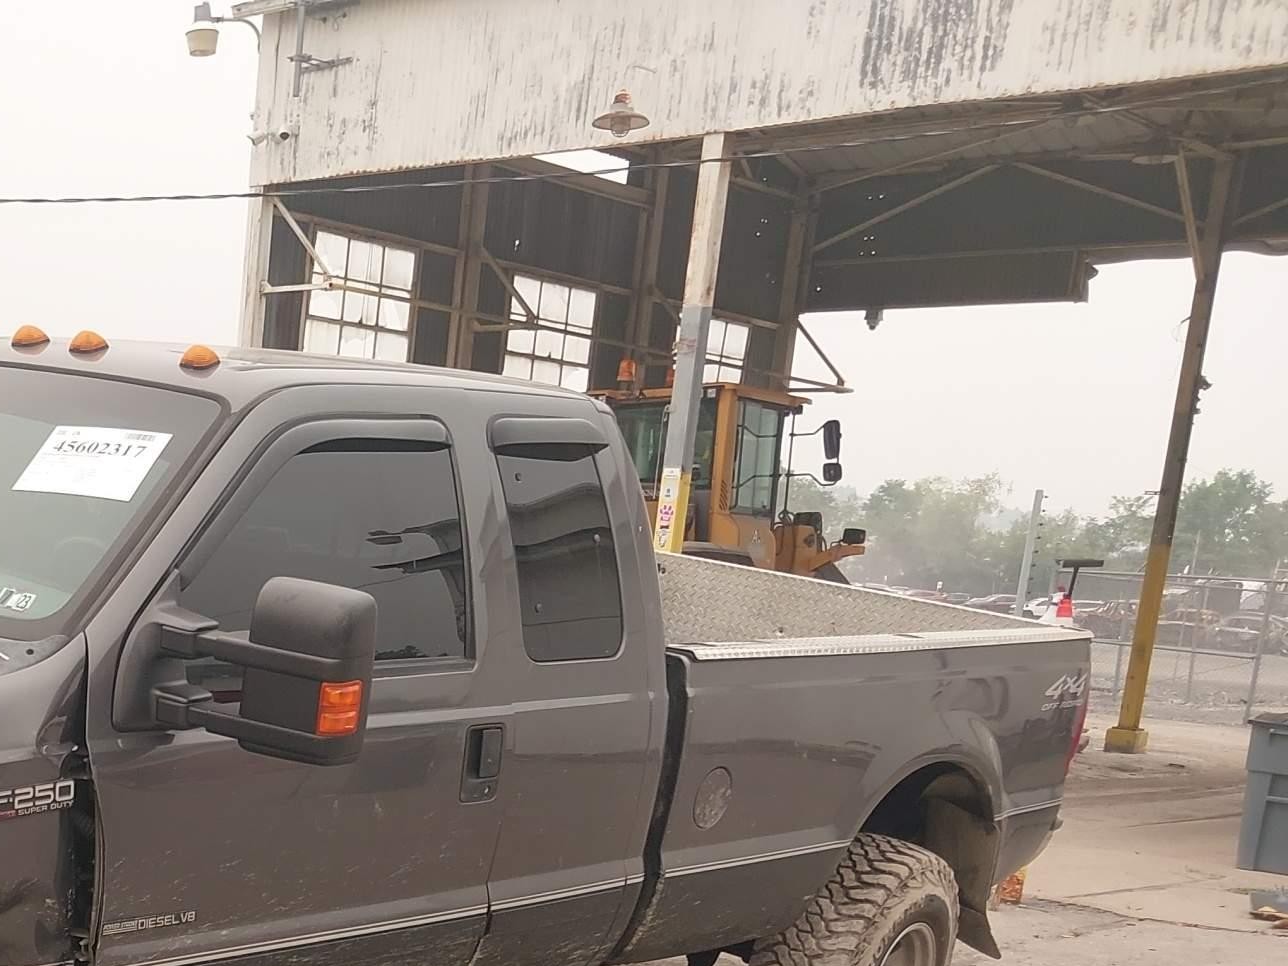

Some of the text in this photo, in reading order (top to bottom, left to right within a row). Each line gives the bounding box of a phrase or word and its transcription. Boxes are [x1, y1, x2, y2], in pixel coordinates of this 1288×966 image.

[53, 439, 148, 458] 45602317
[17, 805, 48, 816] SUPER
[50, 800, 74, 810] DUTY
[138, 914, 180, 930] DIESEL
[180, 911, 196, 923] V8
